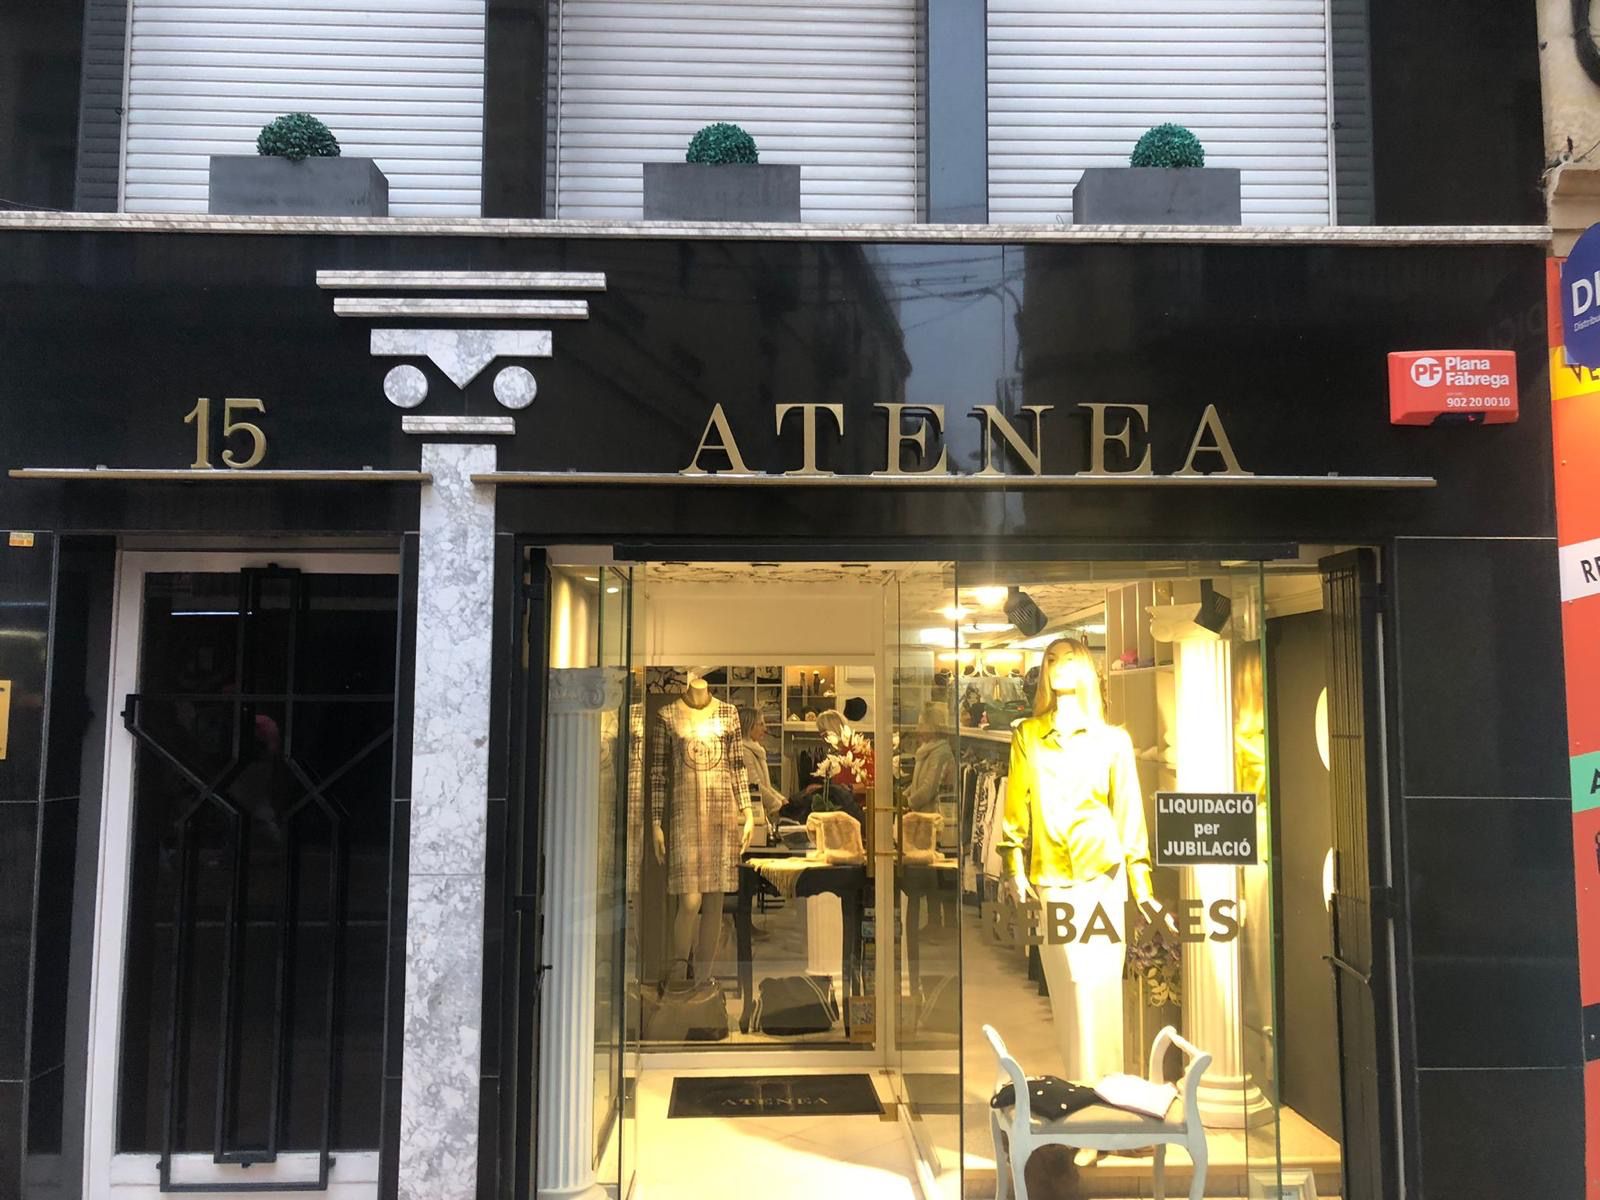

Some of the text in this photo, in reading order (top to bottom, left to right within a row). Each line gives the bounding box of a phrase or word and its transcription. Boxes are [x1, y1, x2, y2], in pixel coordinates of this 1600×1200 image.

[1414, 363, 1441, 381] PF
[1445, 356, 1490, 370] Plana
[1446, 397, 1511, 408] 902 20 00 10
[184, 397, 267, 469] 15
[678, 402, 1255, 476] ATENEA
[1159, 796, 1254, 814] LIQUIDACIÓ
[1194, 821, 1220, 838] per
[1163, 838, 1252, 857] JUBILACIÓ
[720, 1096, 829, 1106] ATENEA
